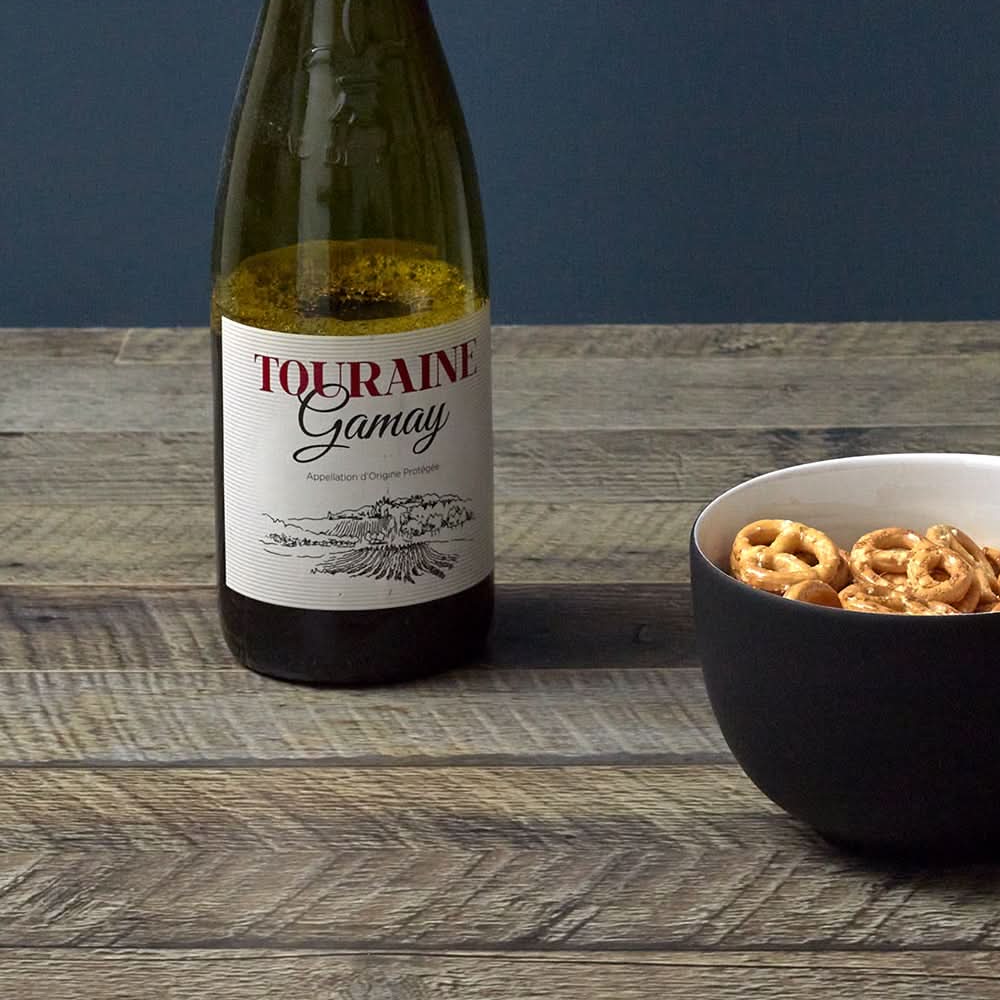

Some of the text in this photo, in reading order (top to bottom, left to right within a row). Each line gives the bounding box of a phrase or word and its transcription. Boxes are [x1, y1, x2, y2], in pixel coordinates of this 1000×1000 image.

[254, 338, 478, 398] TOURAINE
[293, 383, 450, 463] Gamay
[306, 472, 358, 482] Appellation
[360, 471, 401, 482] d'Origine
